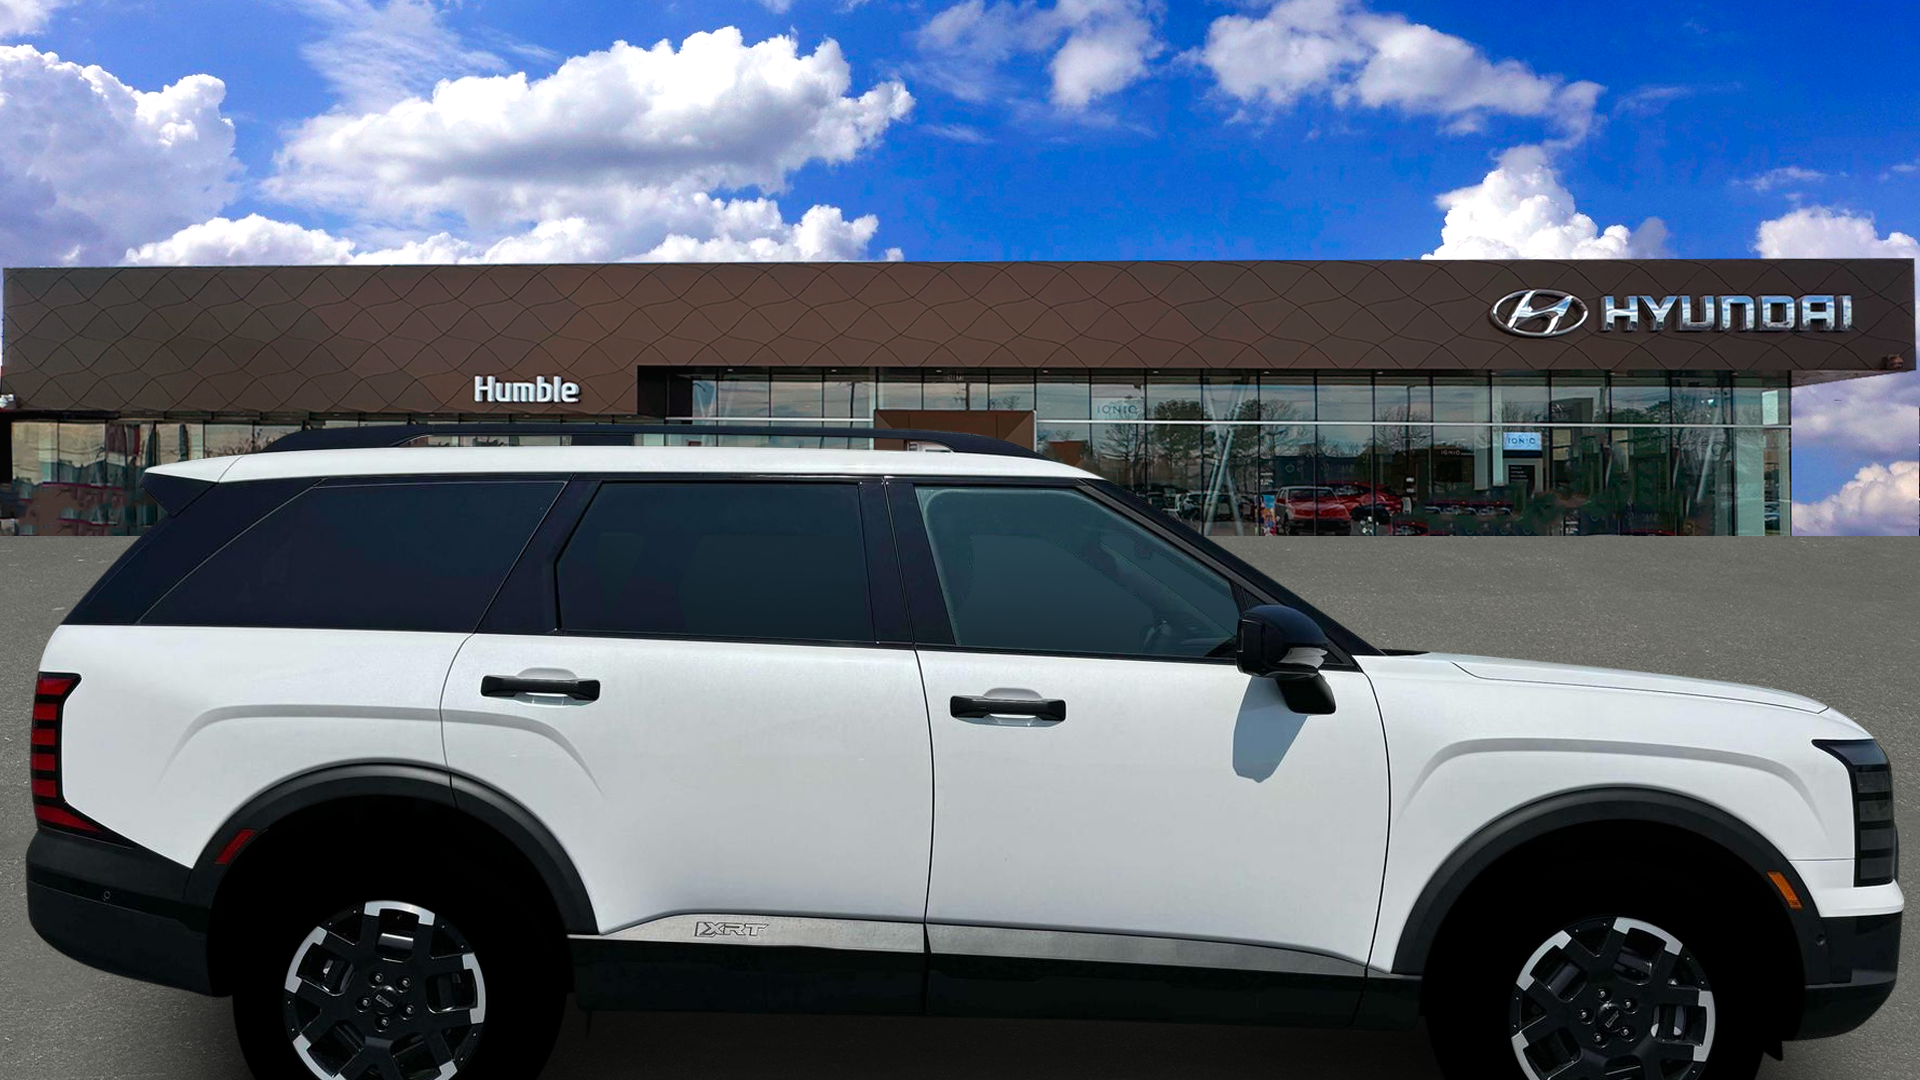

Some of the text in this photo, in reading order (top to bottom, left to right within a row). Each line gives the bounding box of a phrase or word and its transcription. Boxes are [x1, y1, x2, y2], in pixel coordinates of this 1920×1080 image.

[1601, 295, 1852, 332] HYUNDAI
[474, 375, 580, 403] Humble
[695, 921, 769, 938] XRT
